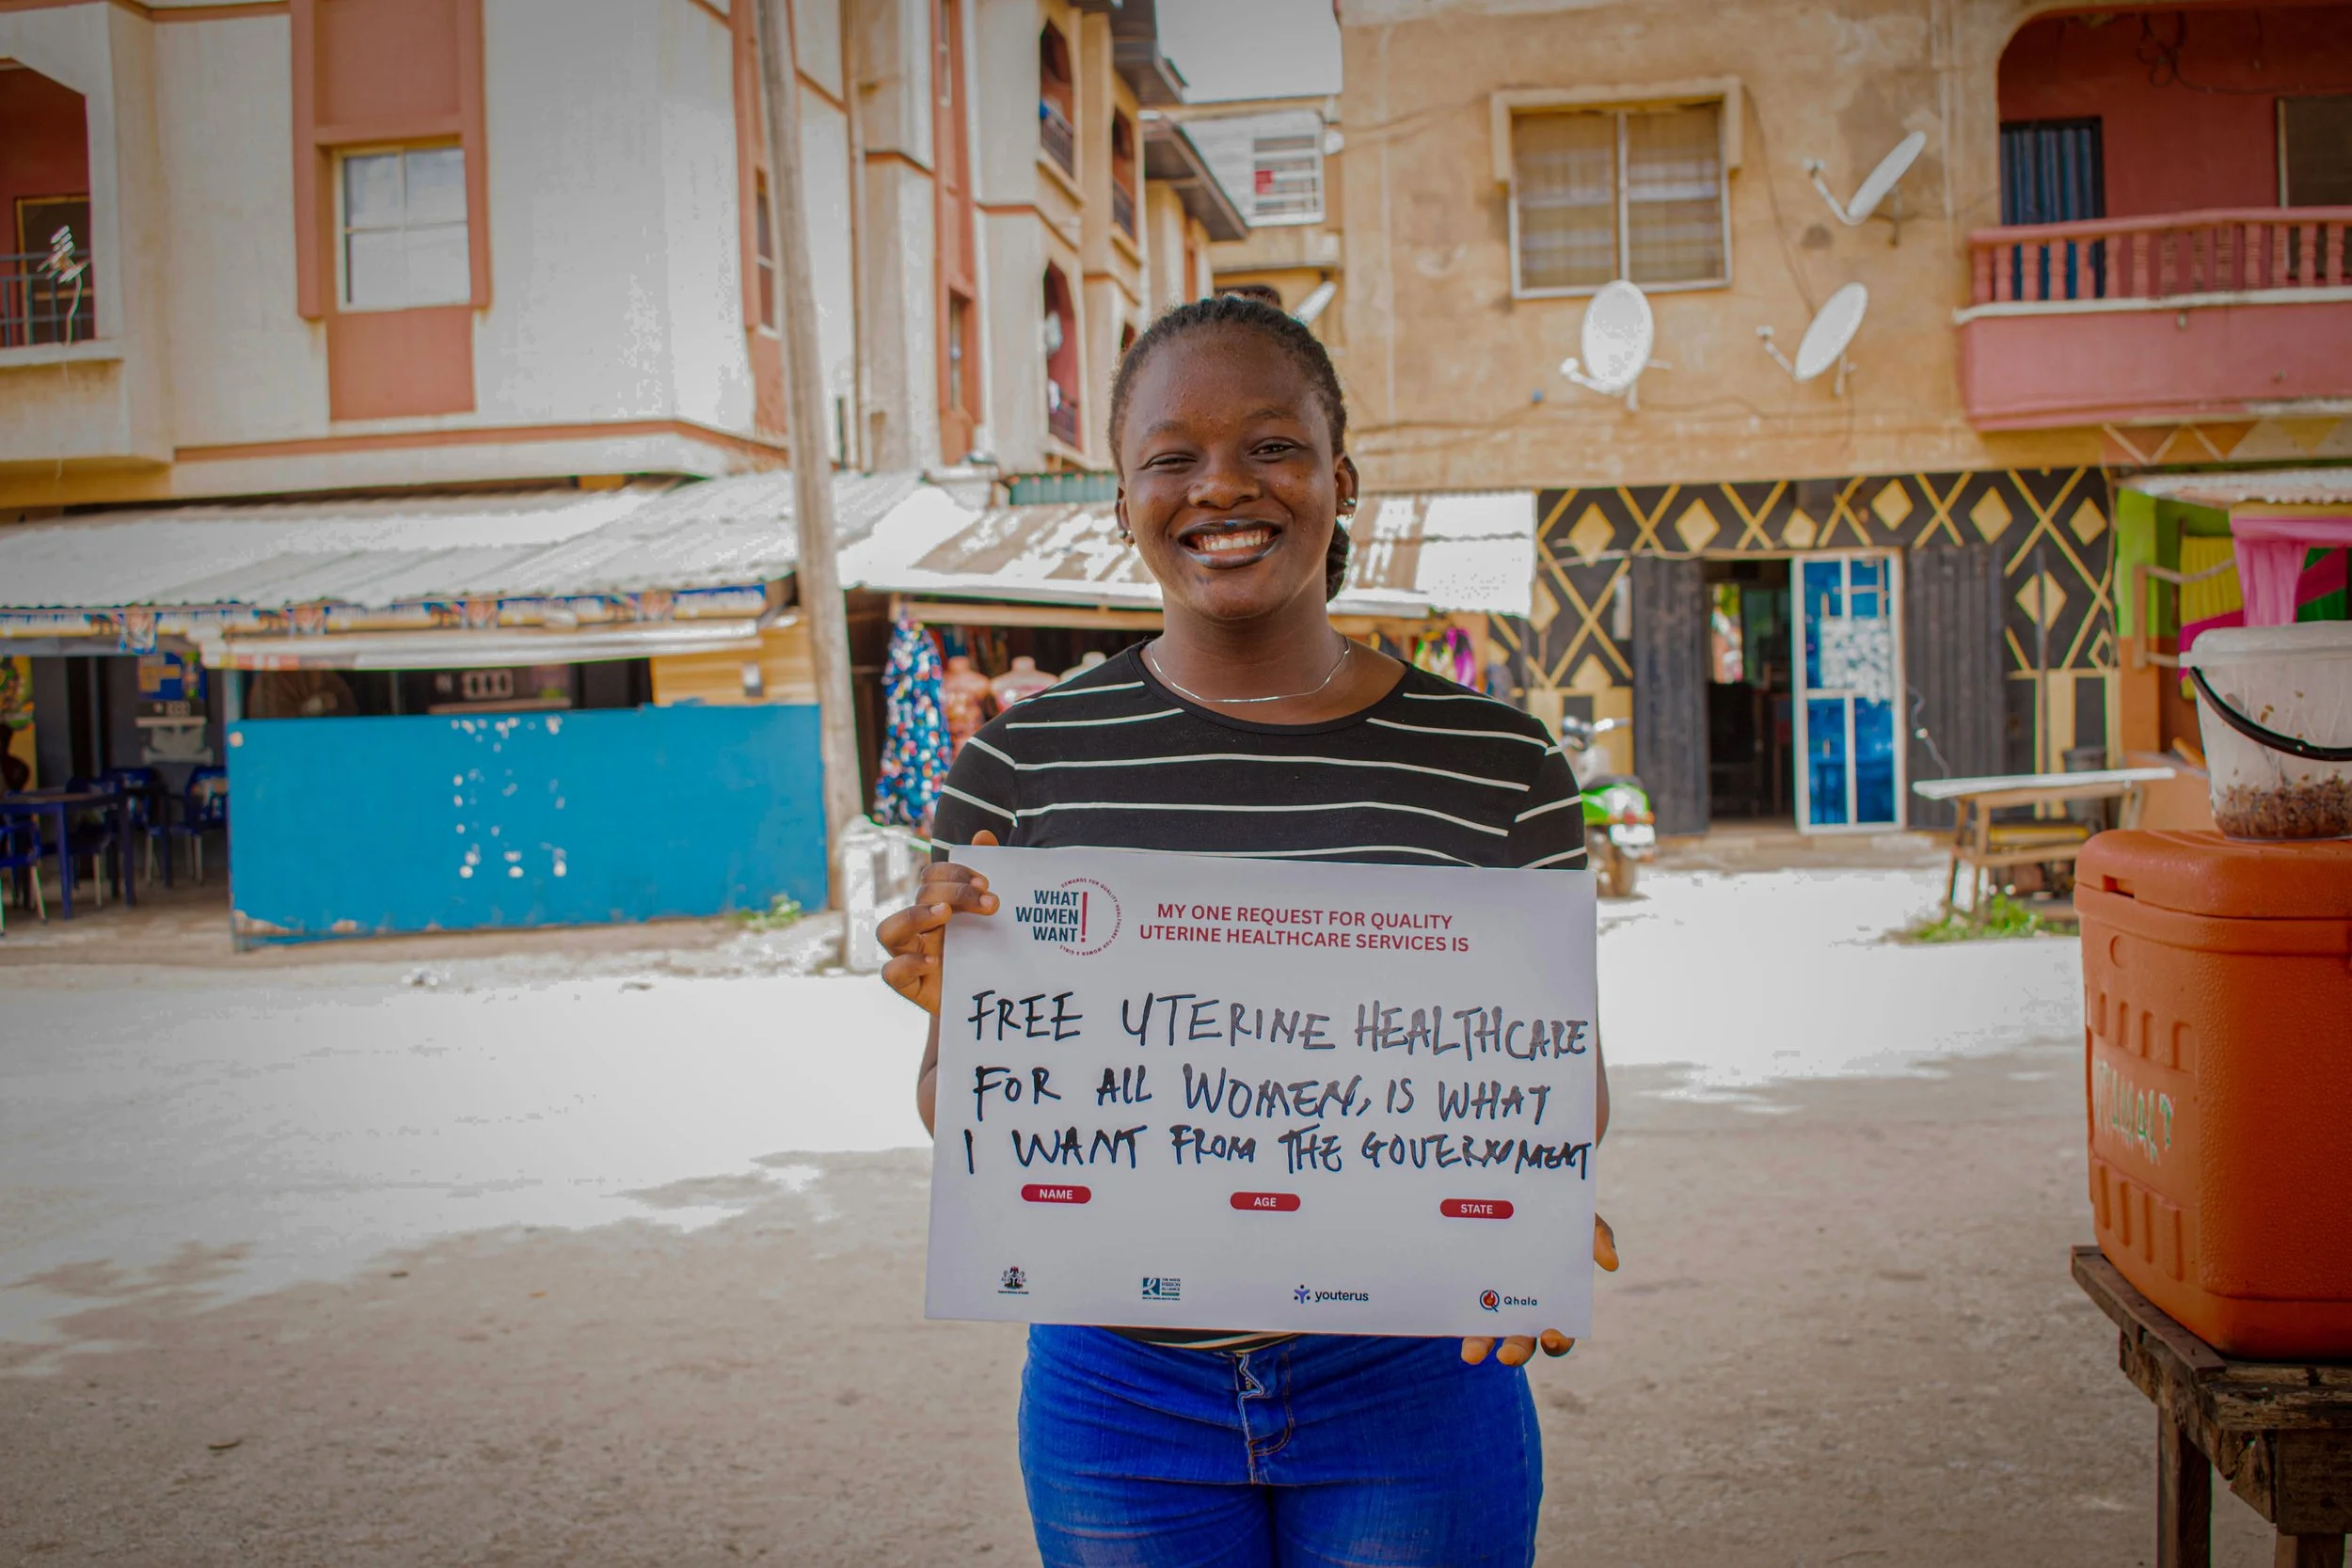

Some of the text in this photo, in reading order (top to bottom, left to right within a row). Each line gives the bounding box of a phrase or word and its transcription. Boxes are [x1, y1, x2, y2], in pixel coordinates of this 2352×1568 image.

[1034, 890, 1079, 906] WHAT
[1015, 906, 1078, 925] WOMEN
[1157, 903, 1453, 930] MY ONE REQUEST FOR QUALITY
[1032, 926, 1078, 942] WANT
[1139, 925, 1469, 952] UTERINE HEALTHCARE SERVICES IS
[967, 990, 1588, 1061] FREE UTERINE HEALTHCARE
[972, 1063, 1551, 1125] FOR ALL WOMEN, IS WHAT
[964, 1128, 975, 1175] I
[1011, 1125, 1148, 1169] WANT
[1168, 1124, 1256, 1164] FROM
[1278, 1123, 1343, 1174] THE
[1039, 1188, 1073, 1200] NAME
[1253, 1196, 1277, 1208] AGE
[1460, 1203, 1494, 1214] STATE
[1314, 1290, 1369, 1303] youterus
[1503, 1295, 1537, 1306] Qhala
